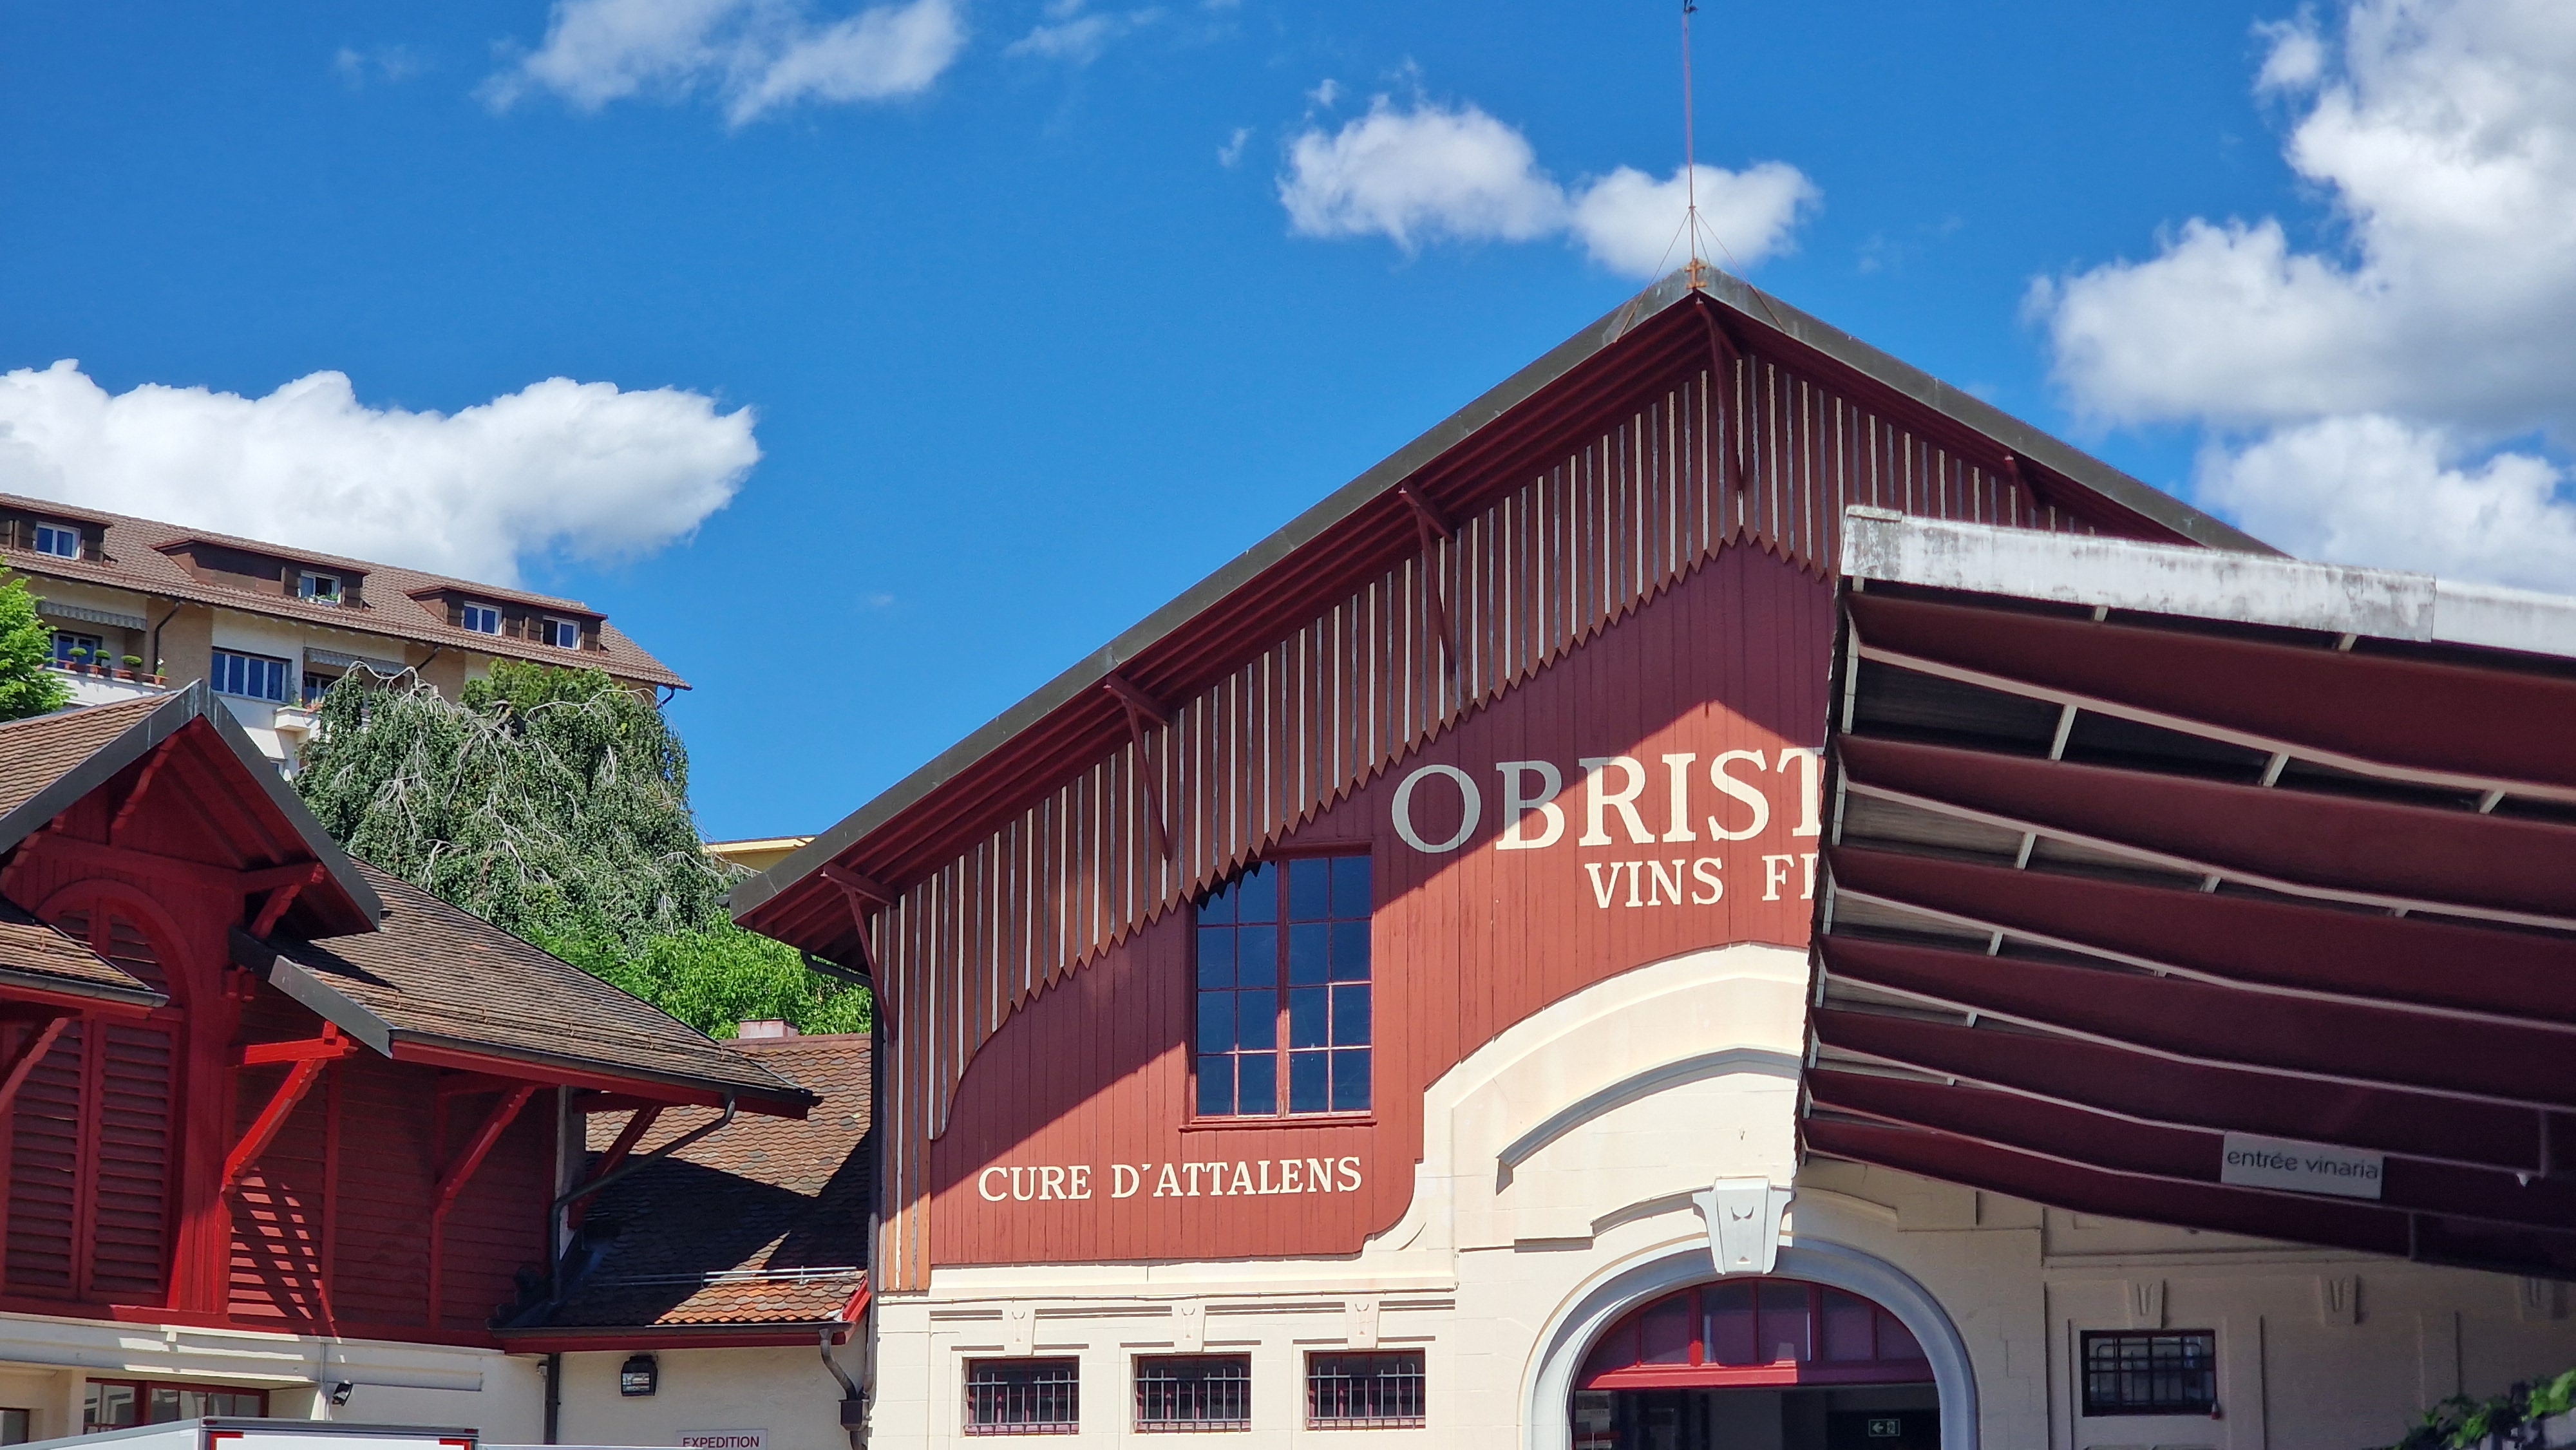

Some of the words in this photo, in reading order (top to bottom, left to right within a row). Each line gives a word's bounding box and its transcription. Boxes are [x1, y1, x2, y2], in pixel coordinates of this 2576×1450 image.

[1392, 747, 1824, 853] OBRIST
[1584, 856, 1724, 909] VINS
[978, 1165, 1093, 1201] CURE
[1111, 1156, 1363, 1199] D'ATTALENS
[2226, 1150, 2298, 1171] entrée
[2306, 1156, 2378, 1180] vinaria
[683, 1436, 760, 1448] EXPEDITION
